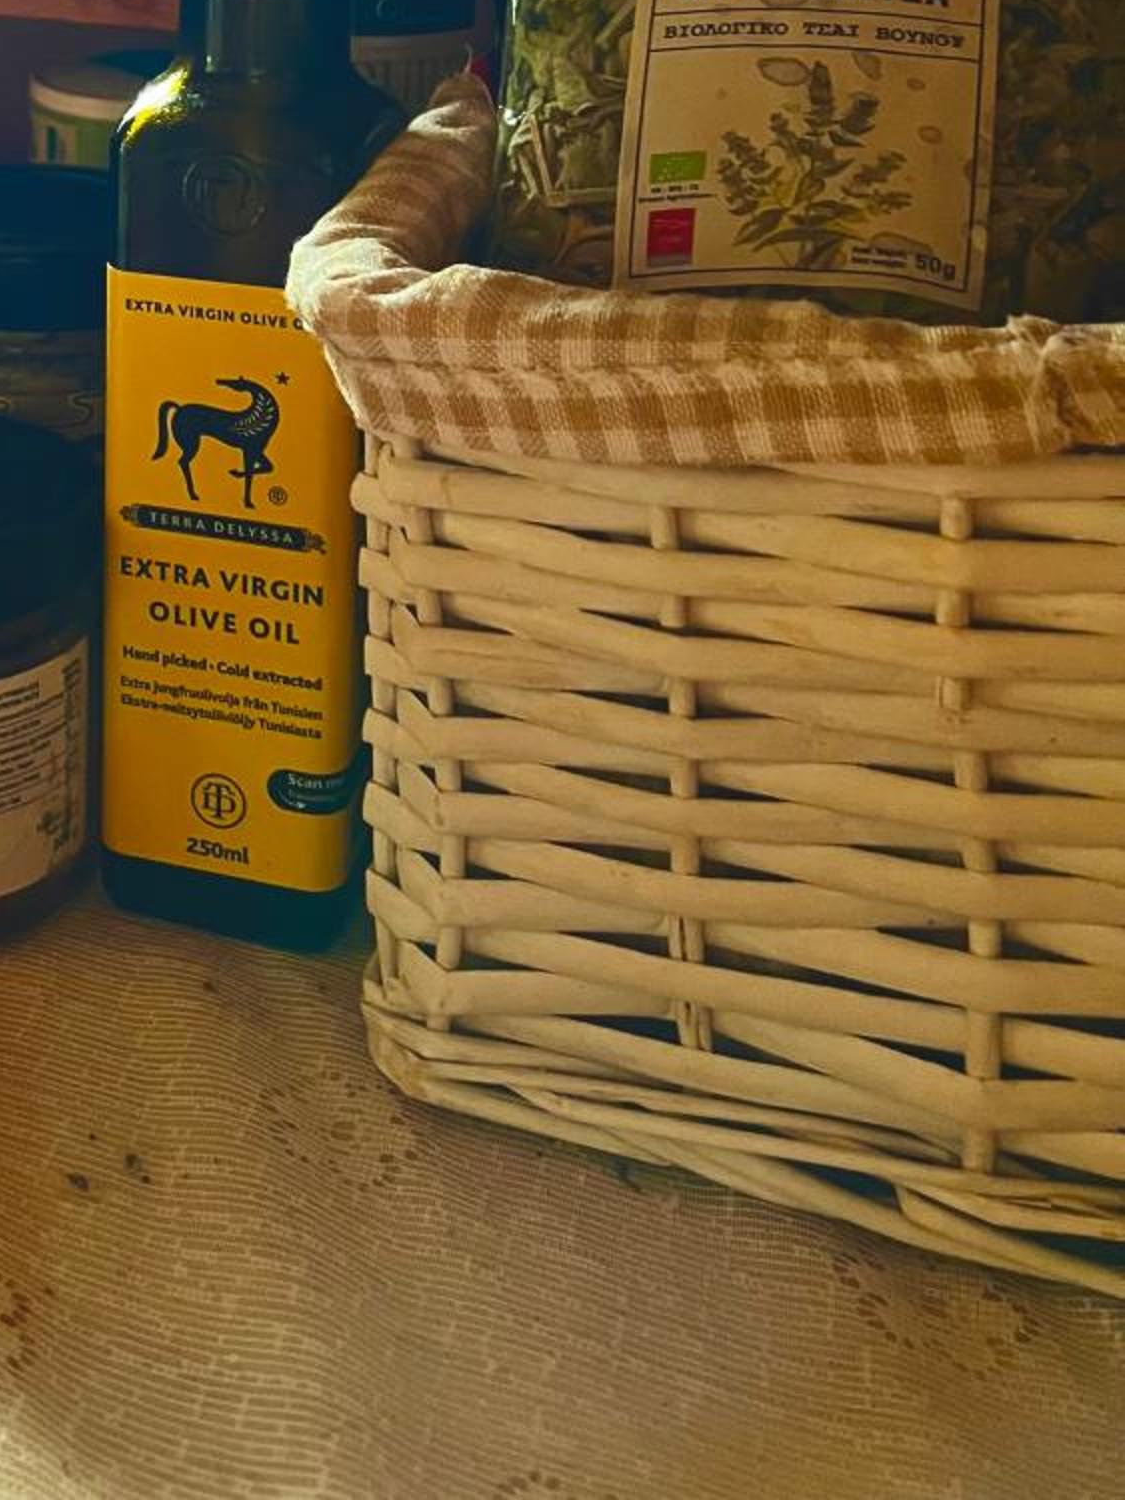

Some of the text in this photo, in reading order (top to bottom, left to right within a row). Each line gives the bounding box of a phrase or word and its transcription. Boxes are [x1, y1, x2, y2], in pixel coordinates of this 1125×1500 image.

[664, 21, 790, 39] ΒΙΟΛΟΓΙΚΟ
[916, 253, 956, 280] 50g
[125, 298, 174, 315] EXTRA
[178, 304, 236, 323] VIRGIN
[240, 312, 287, 329] OLIVE
[148, 510, 294, 545] TERRA DELYSSA
[120, 556, 325, 607] EXTRA VIRGIN
[149, 600, 300, 645] OLIVE OIL
[122, 645, 323, 692] Hand picked Cold extracted
[186, 837, 250, 865] 250ml
